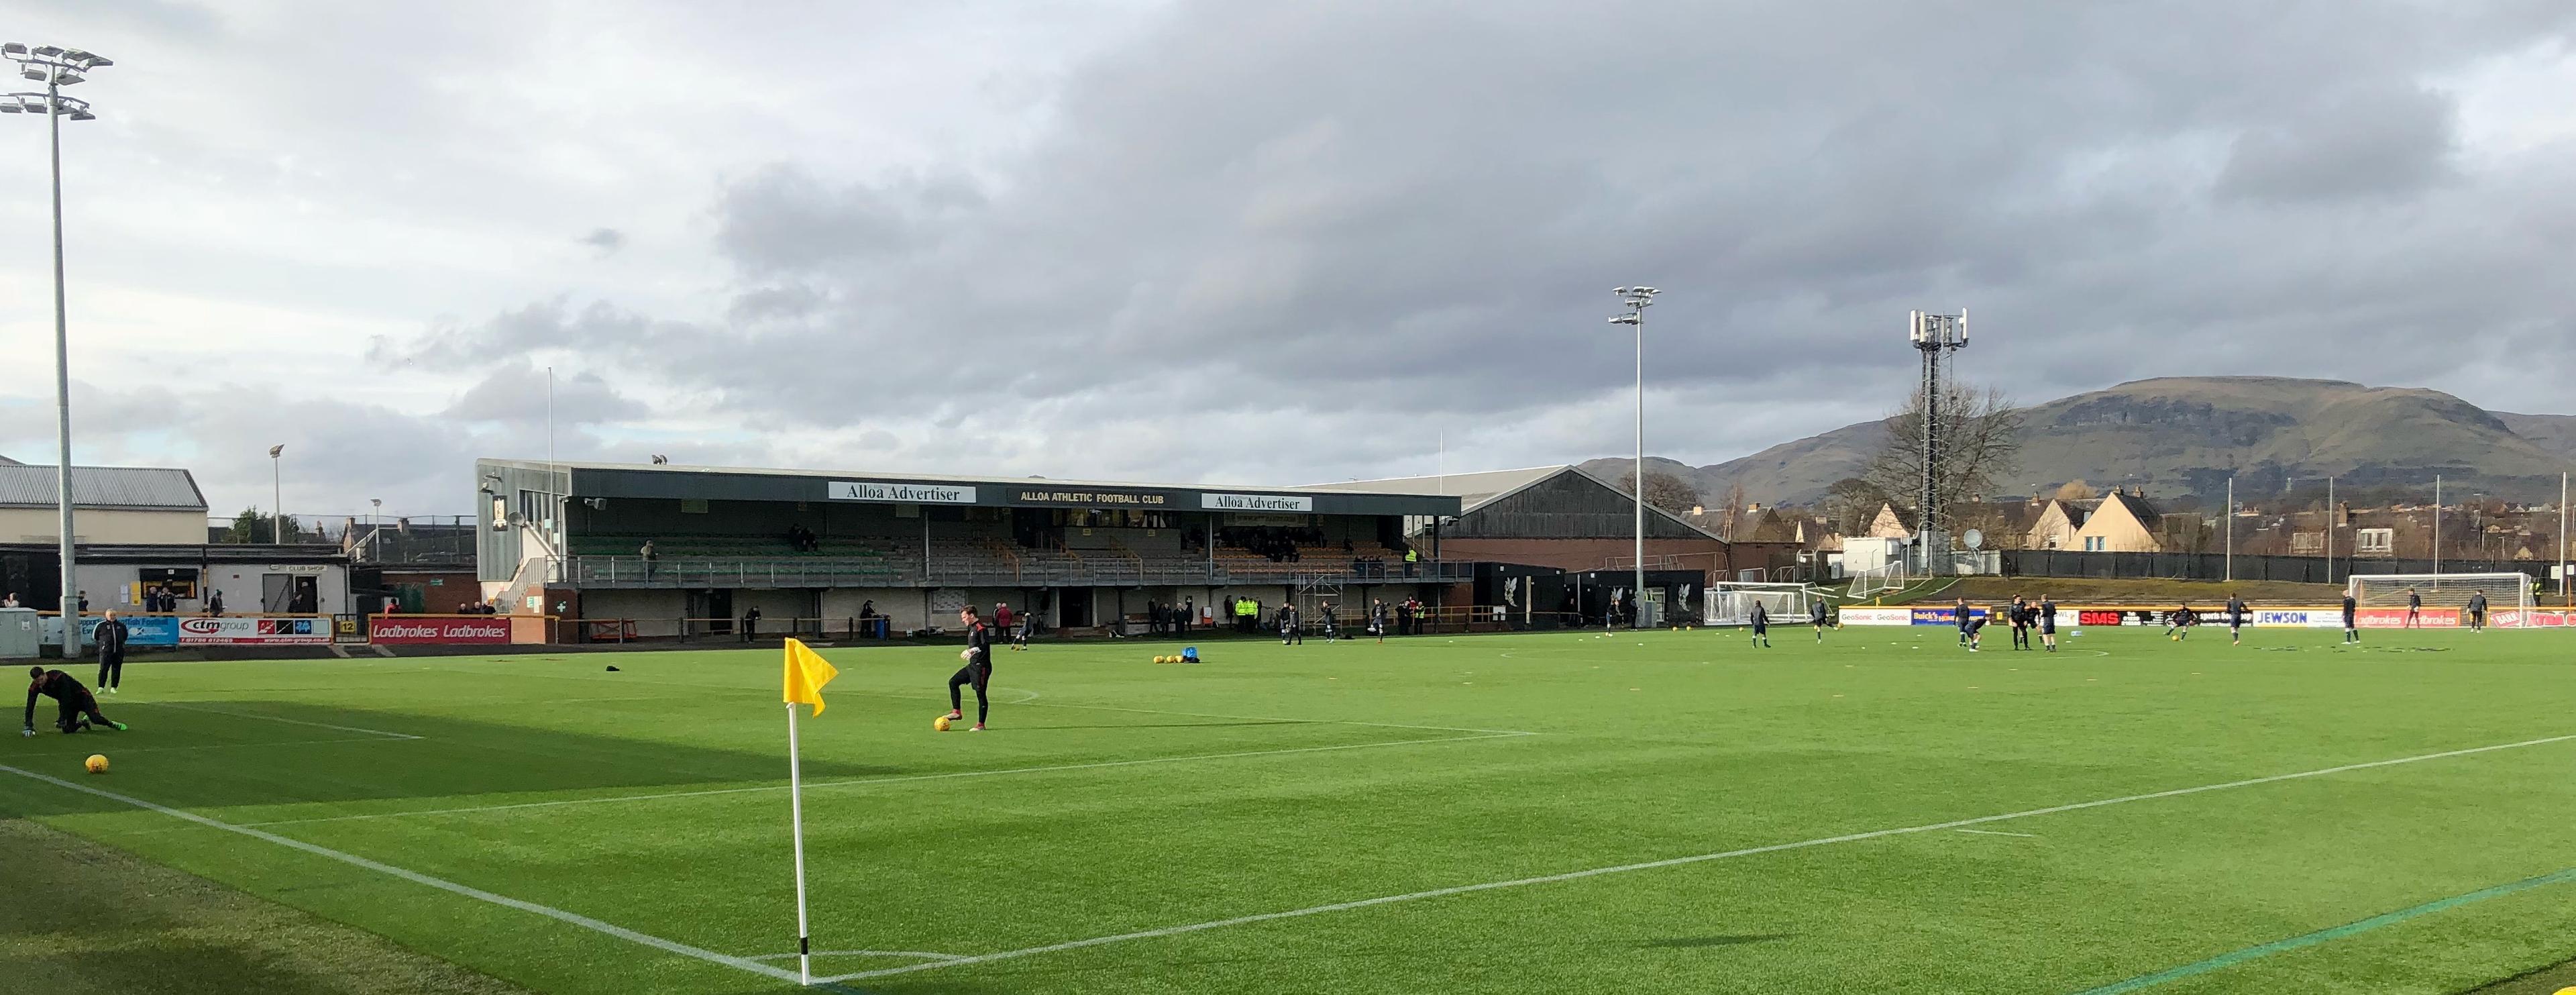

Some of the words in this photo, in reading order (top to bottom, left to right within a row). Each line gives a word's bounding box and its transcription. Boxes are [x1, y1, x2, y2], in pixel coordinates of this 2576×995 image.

[847, 484, 883, 499] Alloa
[888, 486, 960, 501] Advertiser
[1020, 492, 1049, 501] ALLOA
[1051, 492, 1093, 502] ATHLETIC
[1096, 494, 1139, 503] FOOTBALL
[1142, 494, 1164, 503] CLUB
[1215, 496, 1243, 508] Alloa
[1245, 496, 1300, 510] Advertiser
[1914, 612, 1938, 620] Buick's
[2080, 612, 2119, 624] SMS
[2200, 612, 2220, 621] sports
[2257, 612, 2308, 623] JEWSON
[2354, 615, 2401, 625] Ladbrokes
[2496, 612, 2519, 625] BARR
[373, 625, 438, 637] Ladbrokes
[443, 625, 506, 637] Ladbrokes
